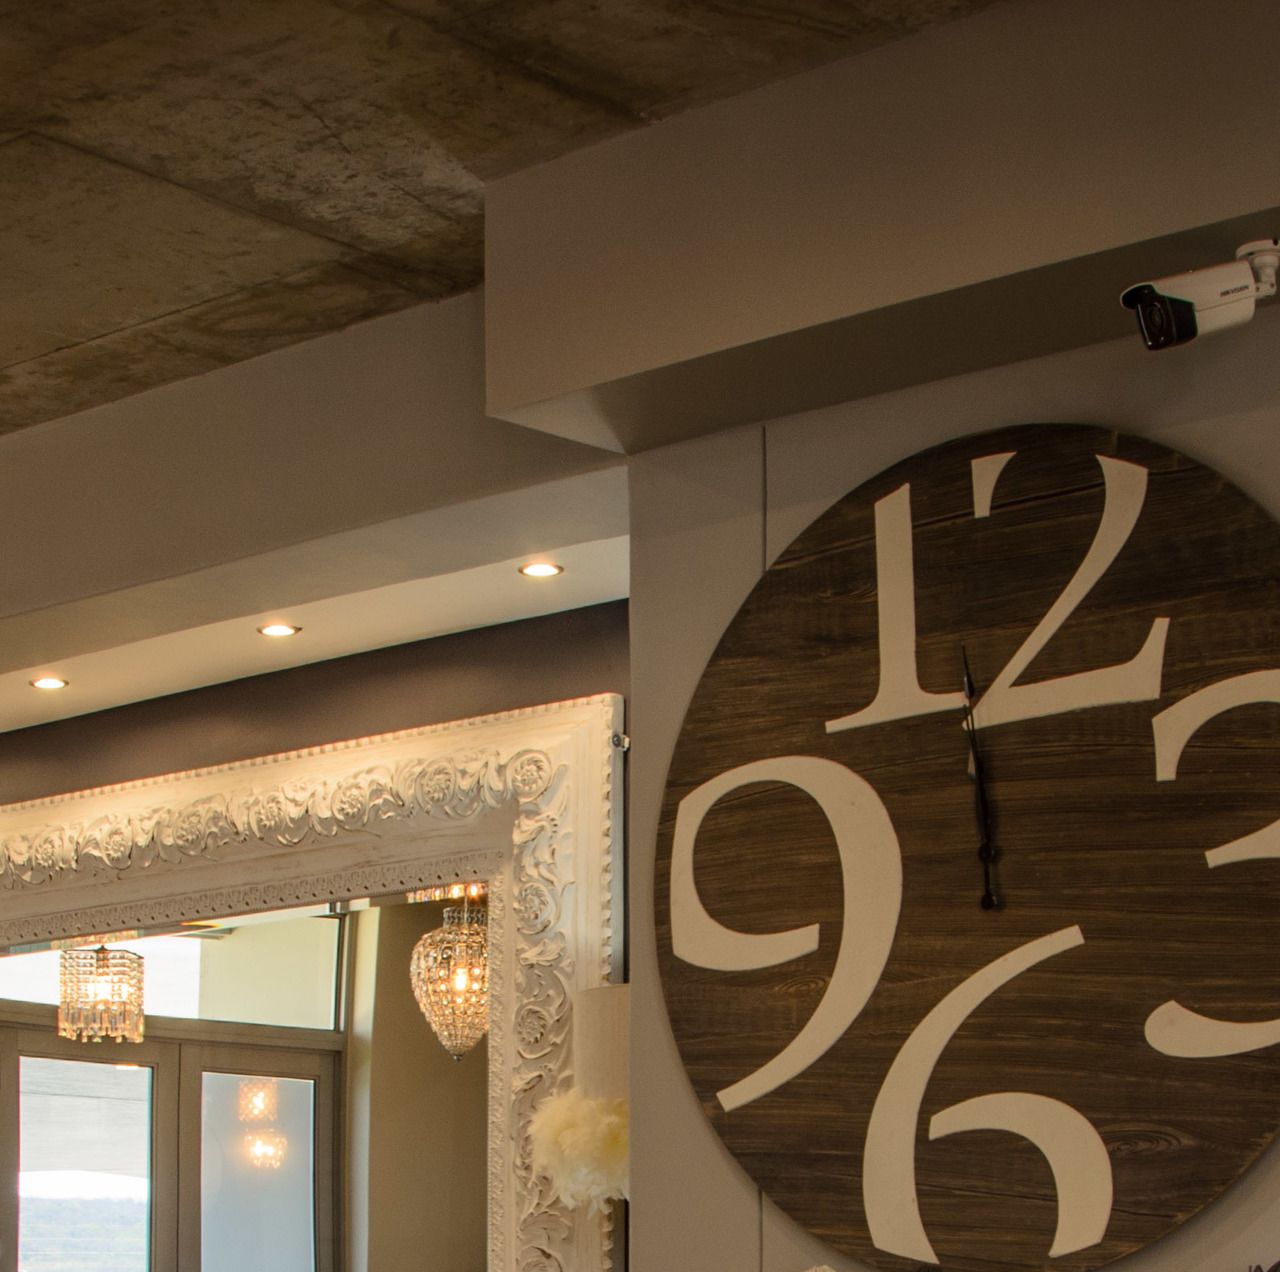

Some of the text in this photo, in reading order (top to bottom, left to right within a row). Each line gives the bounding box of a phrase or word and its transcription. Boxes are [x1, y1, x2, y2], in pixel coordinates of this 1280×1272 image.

[825, 450, 1171, 735] 12
[670, 755, 903, 1112] 9
[862, 923, 1114, 1264] 6
